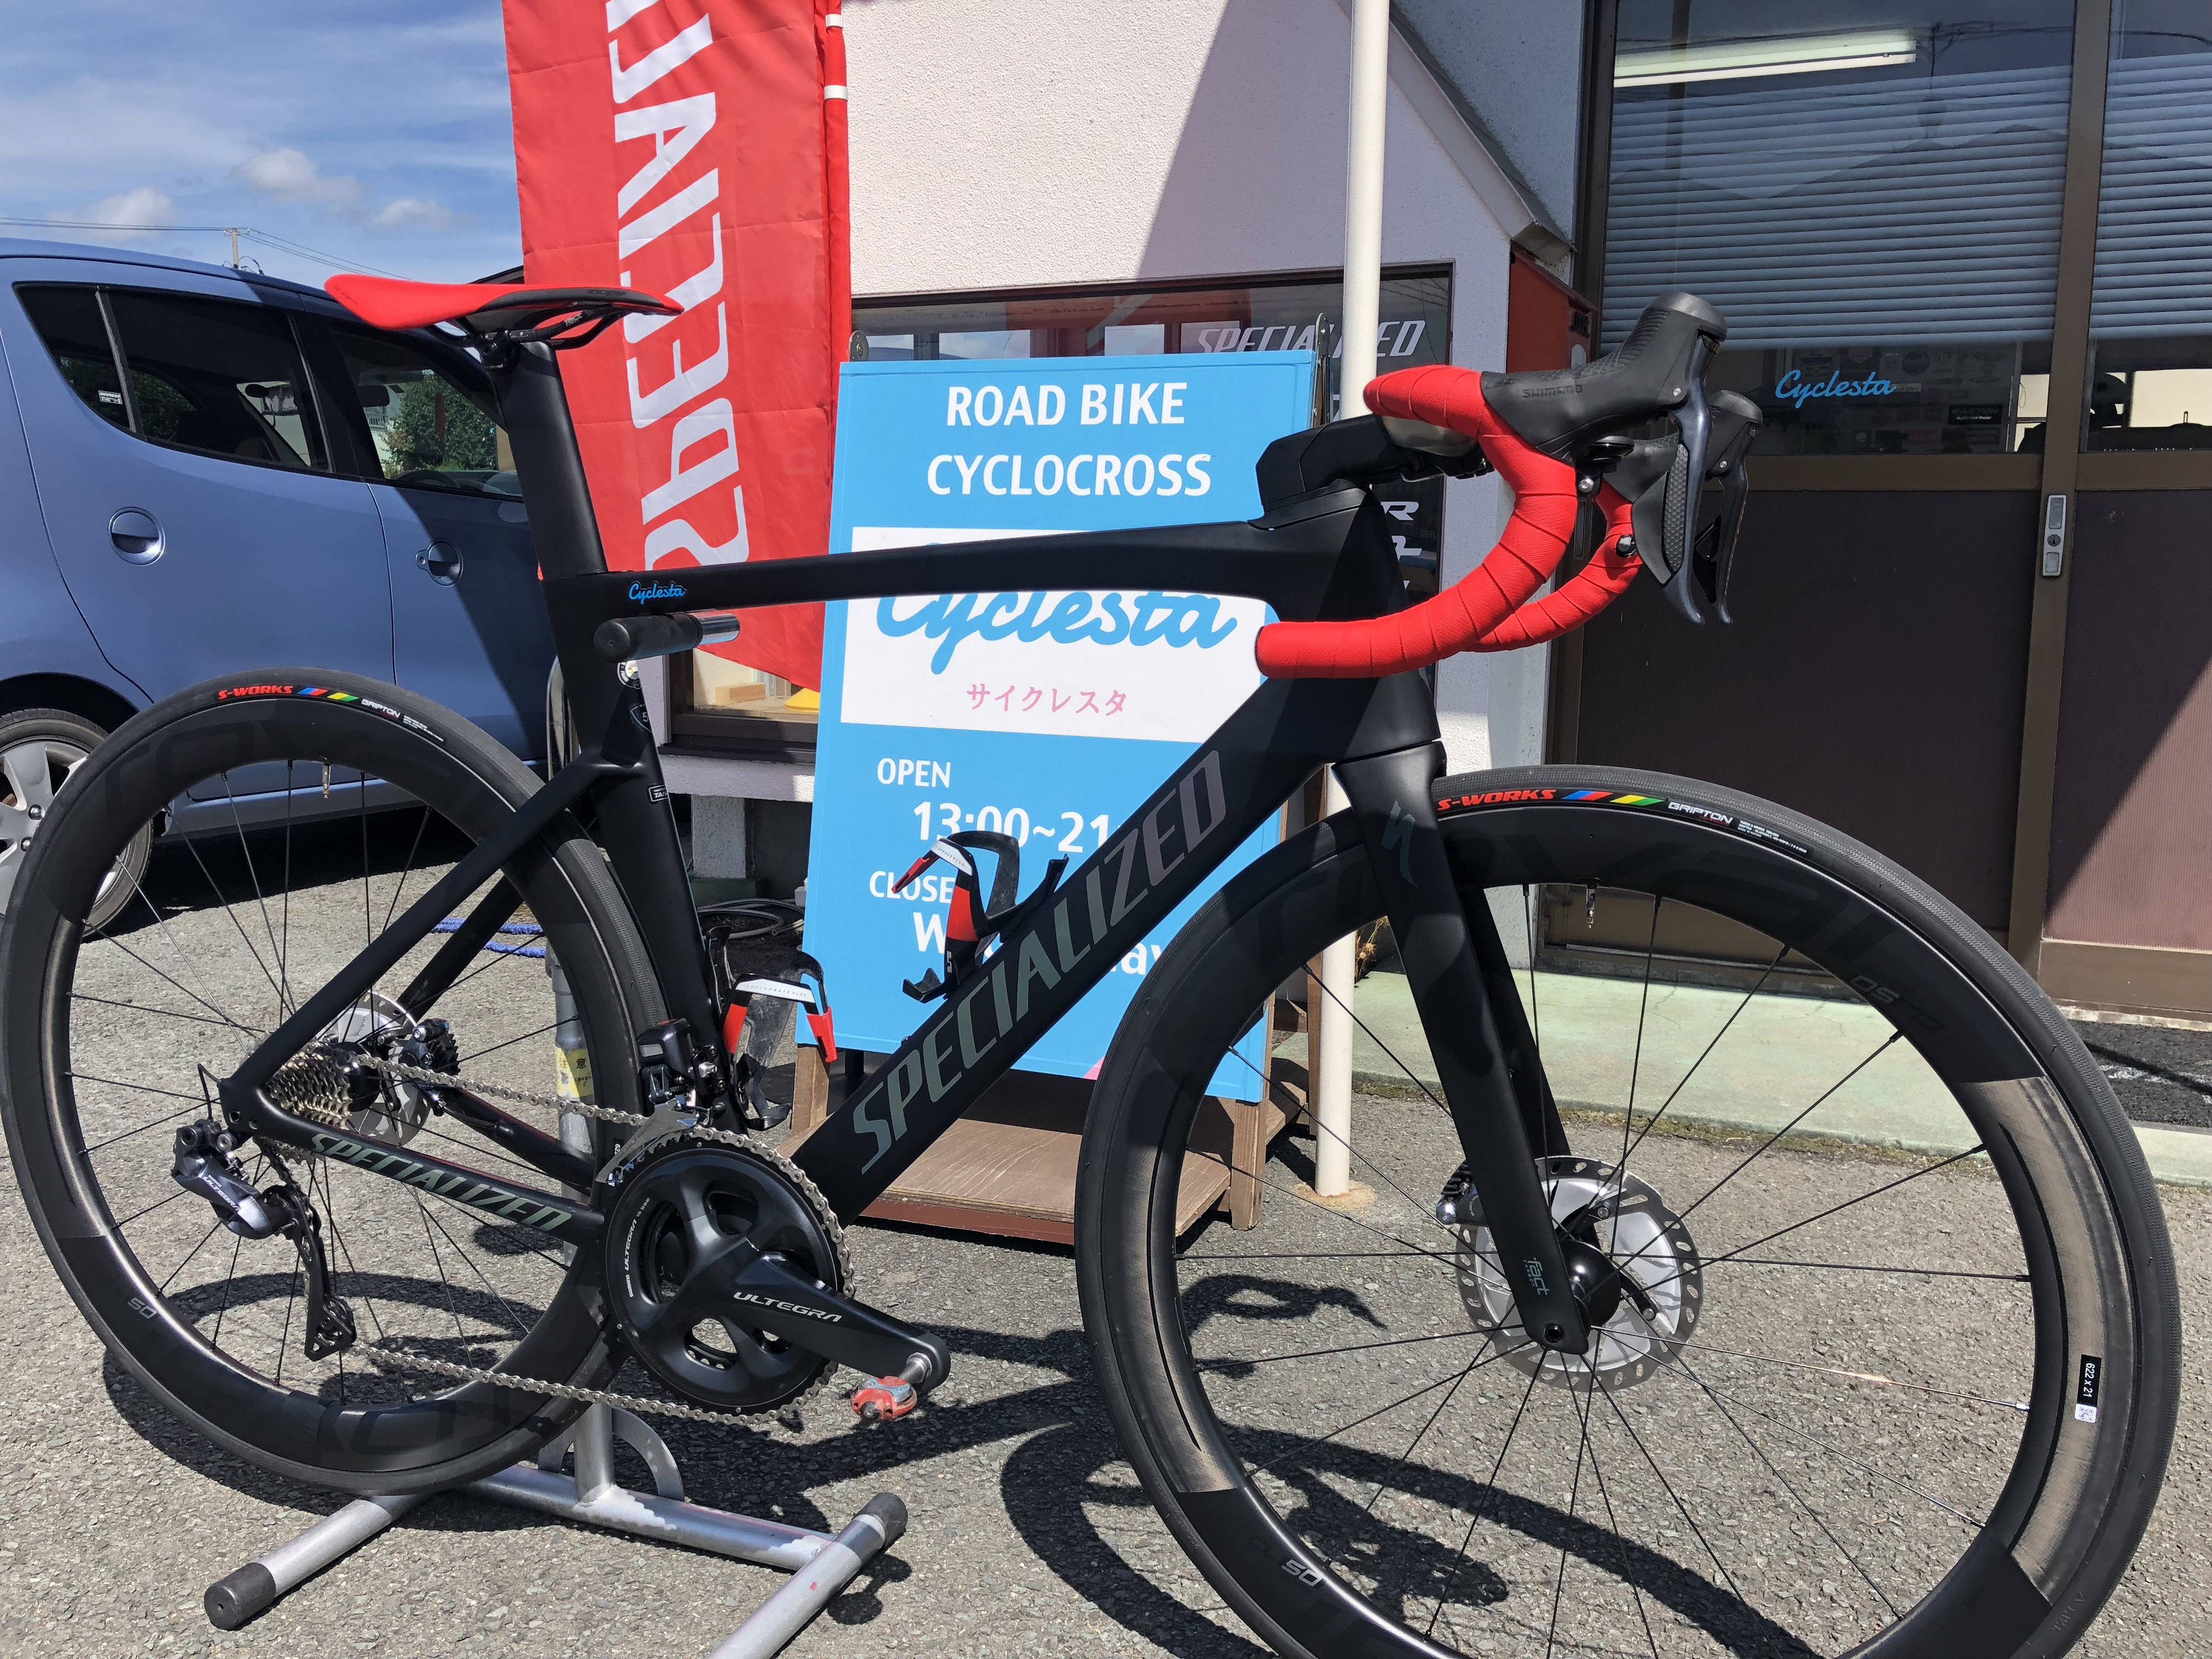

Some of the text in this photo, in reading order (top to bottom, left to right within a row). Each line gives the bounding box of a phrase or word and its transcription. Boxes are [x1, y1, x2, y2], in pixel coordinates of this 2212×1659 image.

[1522, 385, 1583, 398] SHIMANO
[1775, 369, 1897, 408] Cyclesta
[947, 382, 1187, 426] ROAD BIKE
[928, 453, 1212, 497] CYCLOCROSS
[629, 582, 686, 605] Cyclesta
[217, 685, 293, 700] S-WORKS
[966, 684, 1127, 716] サイクレスタ
[362, 698, 400, 719] GRIPTON
[877, 758, 951, 788] OPEN
[1437, 789, 1556, 811] S-WORKS
[1668, 802, 1733, 824] GRIPTON
[853, 750, 1226, 1175] SPECIALIZED
[202, 1176, 241, 1211] ULTEGRA
[312, 1133, 572, 1232] SPECIALIZED
[623, 1218, 637, 1271] ULTEGRA
[625, 1273, 634, 1298] SHIMANO
[1528, 1257, 1550, 1296] fact
[127, 1297, 157, 1319] 50
[733, 1290, 843, 1323] ULTEGRA
[2085, 1363, 2096, 1379] 622
[2083, 1387, 2092, 1398] 21
[1282, 1559, 1322, 1587] 50
